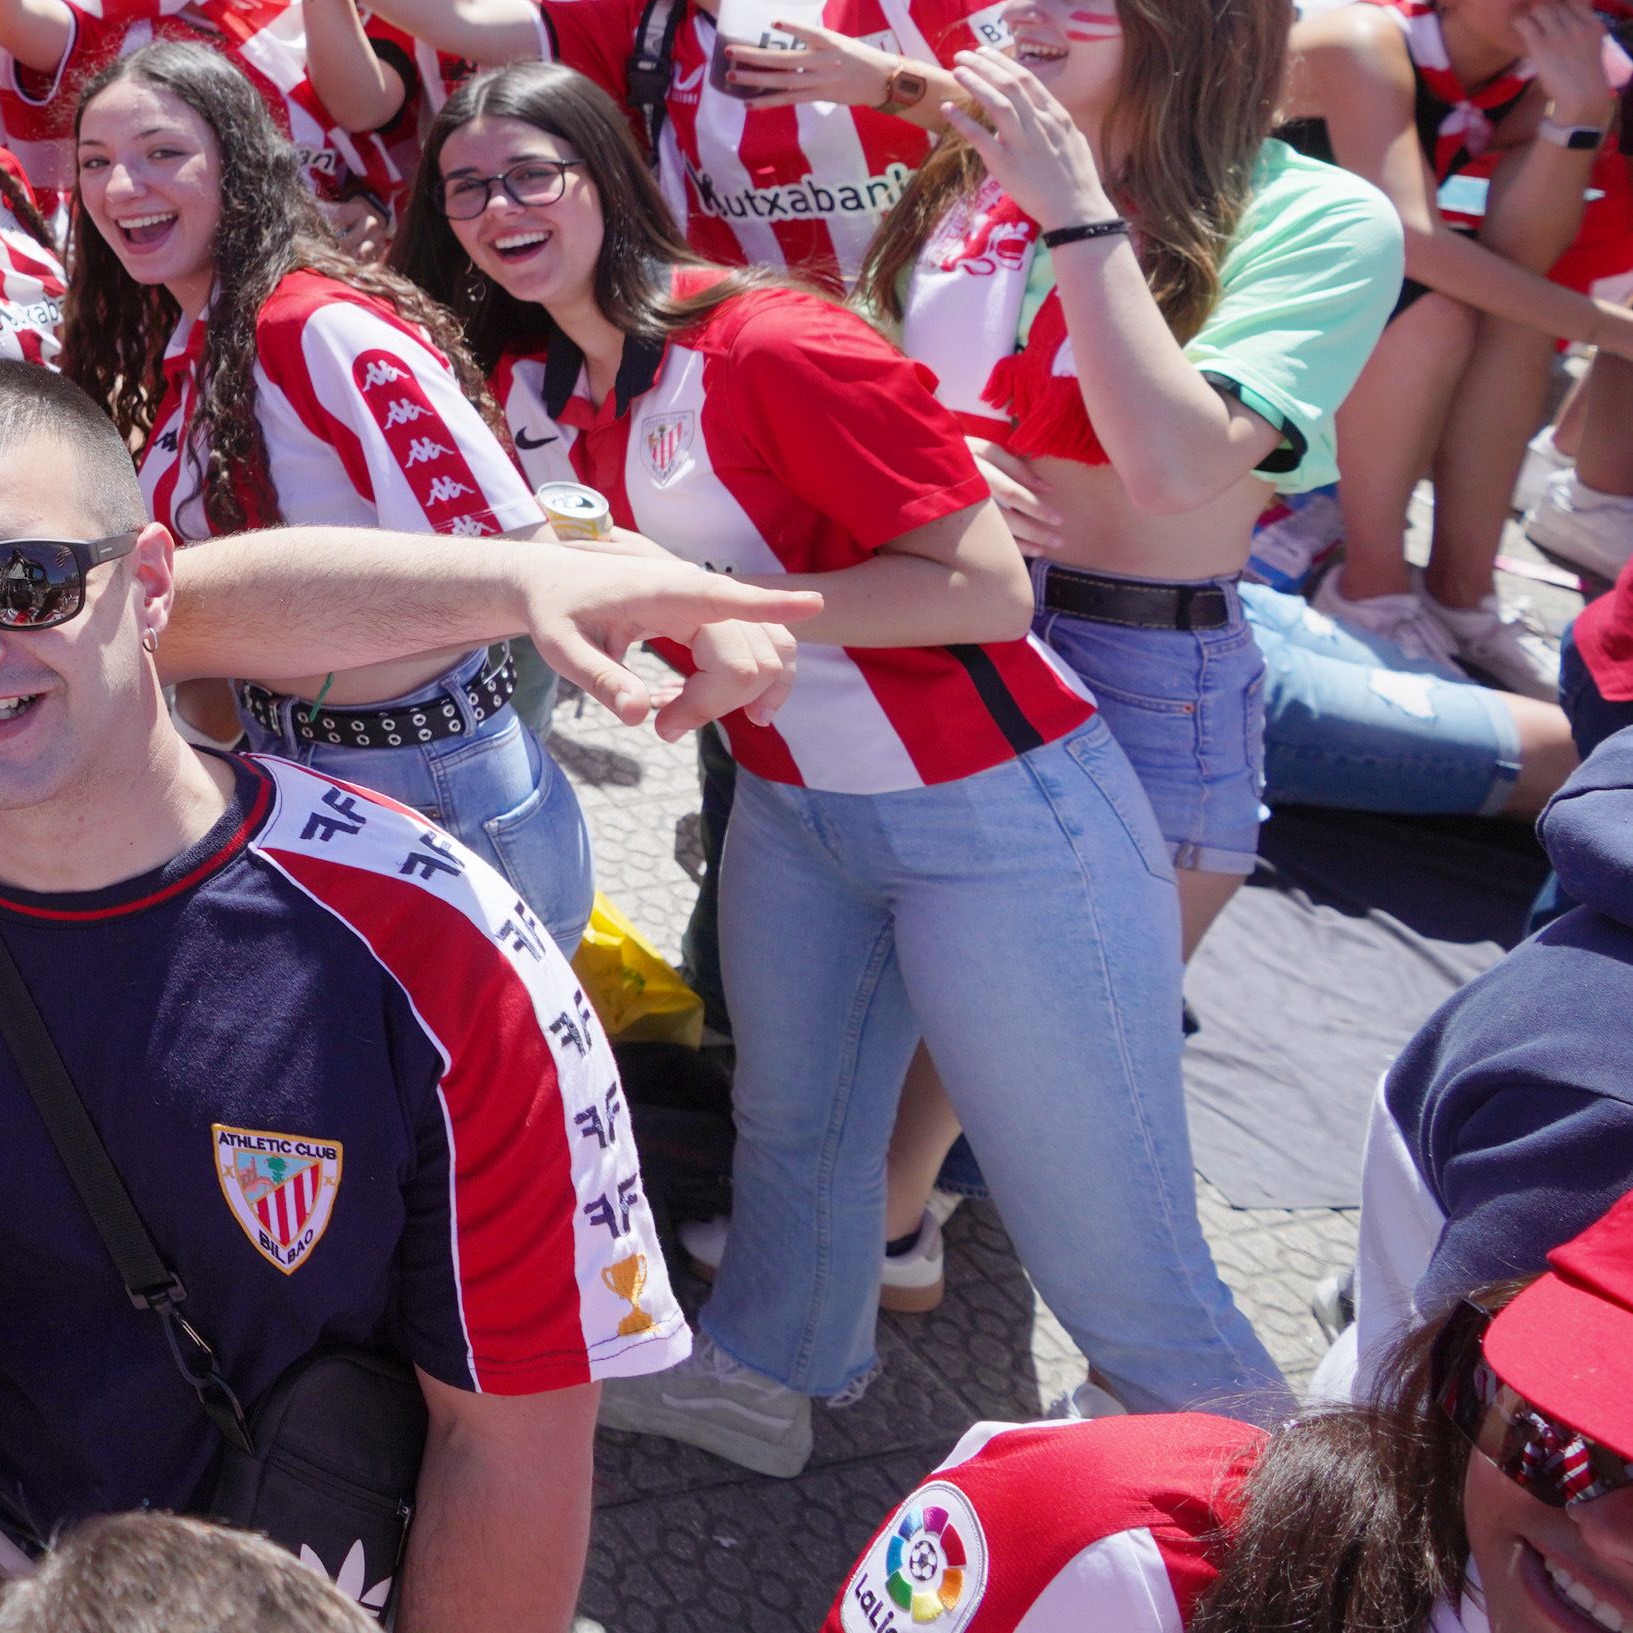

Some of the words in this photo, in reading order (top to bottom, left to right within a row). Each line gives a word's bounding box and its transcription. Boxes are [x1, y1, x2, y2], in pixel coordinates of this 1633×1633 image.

[217, 1130, 292, 1156] ATHLETIC
[295, 1141, 338, 1162] CLUB
[257, 1227, 316, 1268] BILBAO
